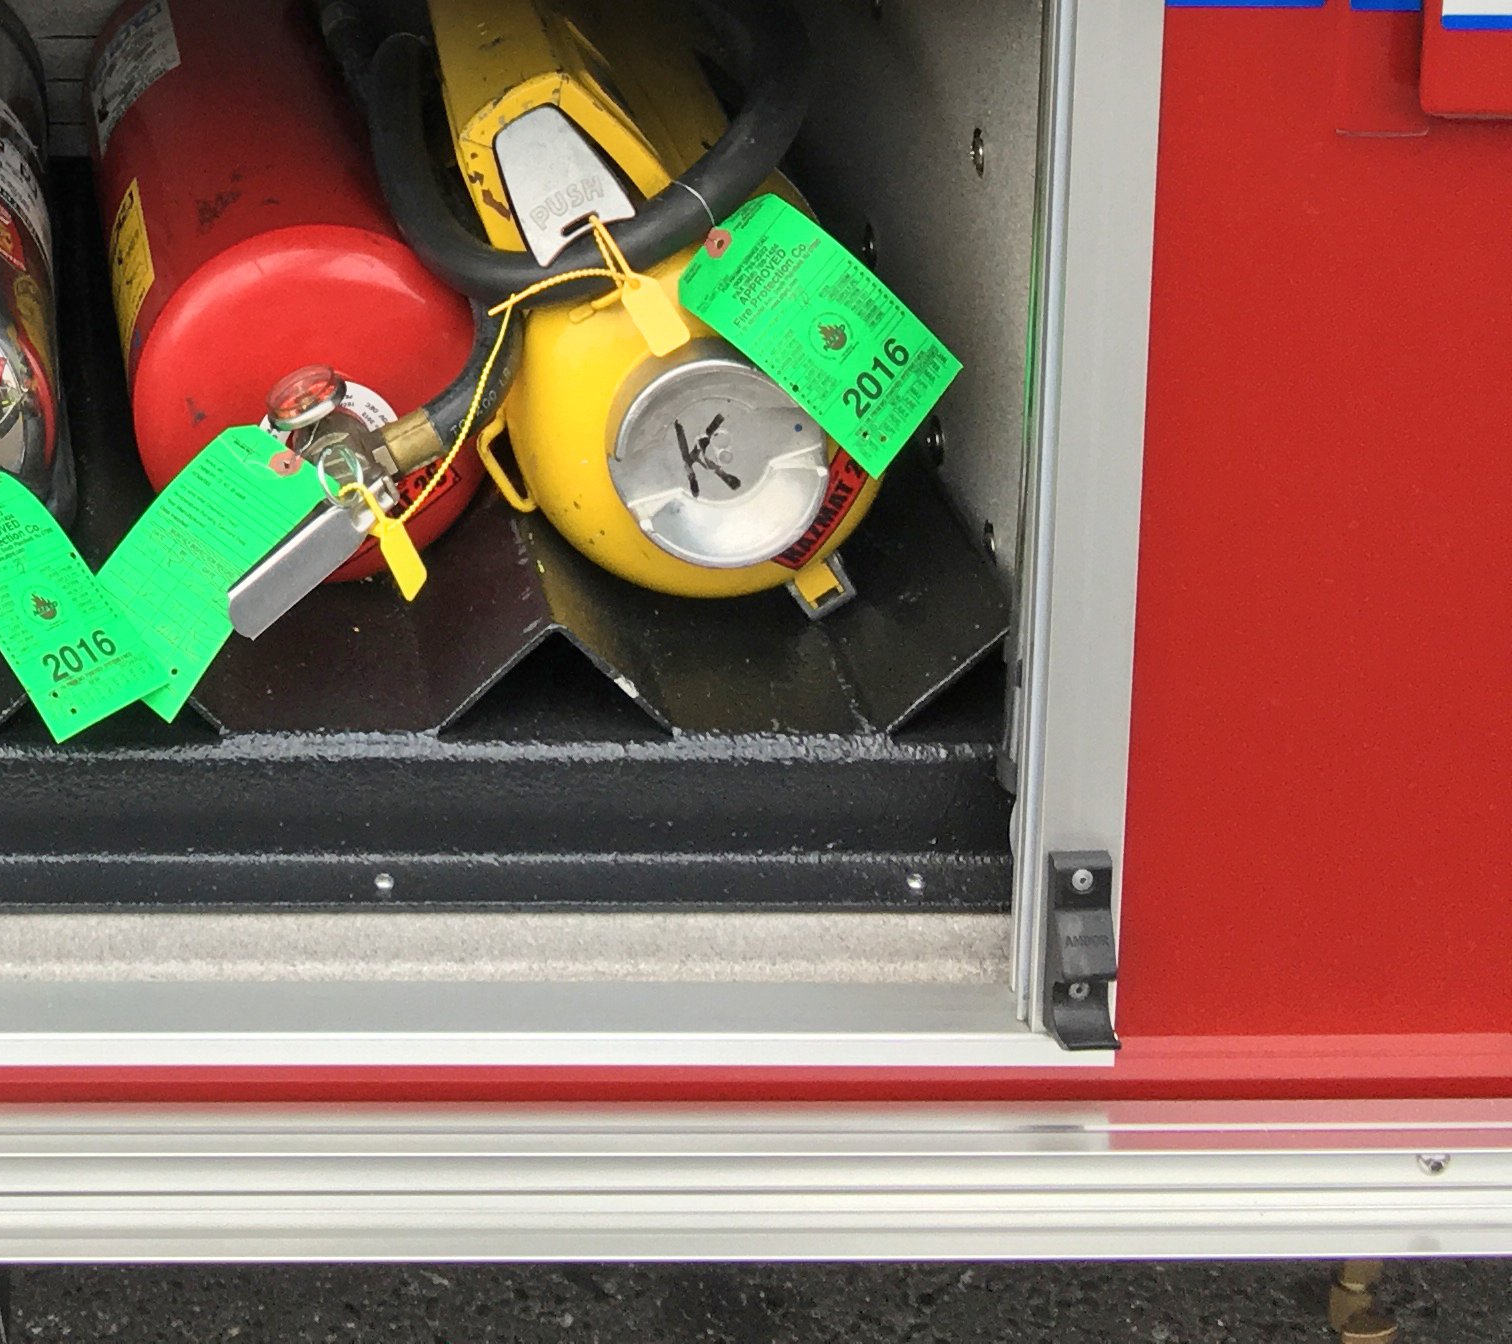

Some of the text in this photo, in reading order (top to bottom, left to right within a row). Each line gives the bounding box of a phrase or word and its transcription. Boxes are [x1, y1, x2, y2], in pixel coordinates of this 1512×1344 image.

[530, 174, 605, 230] PUSH
[732, 305, 754, 329] Fire
[749, 255, 794, 308] Protection
[737, 247, 787, 306] APPROVED
[843, 338, 909, 418] 2016
[672, 412, 741, 498] K
[42, 630, 116, 683] 2016
